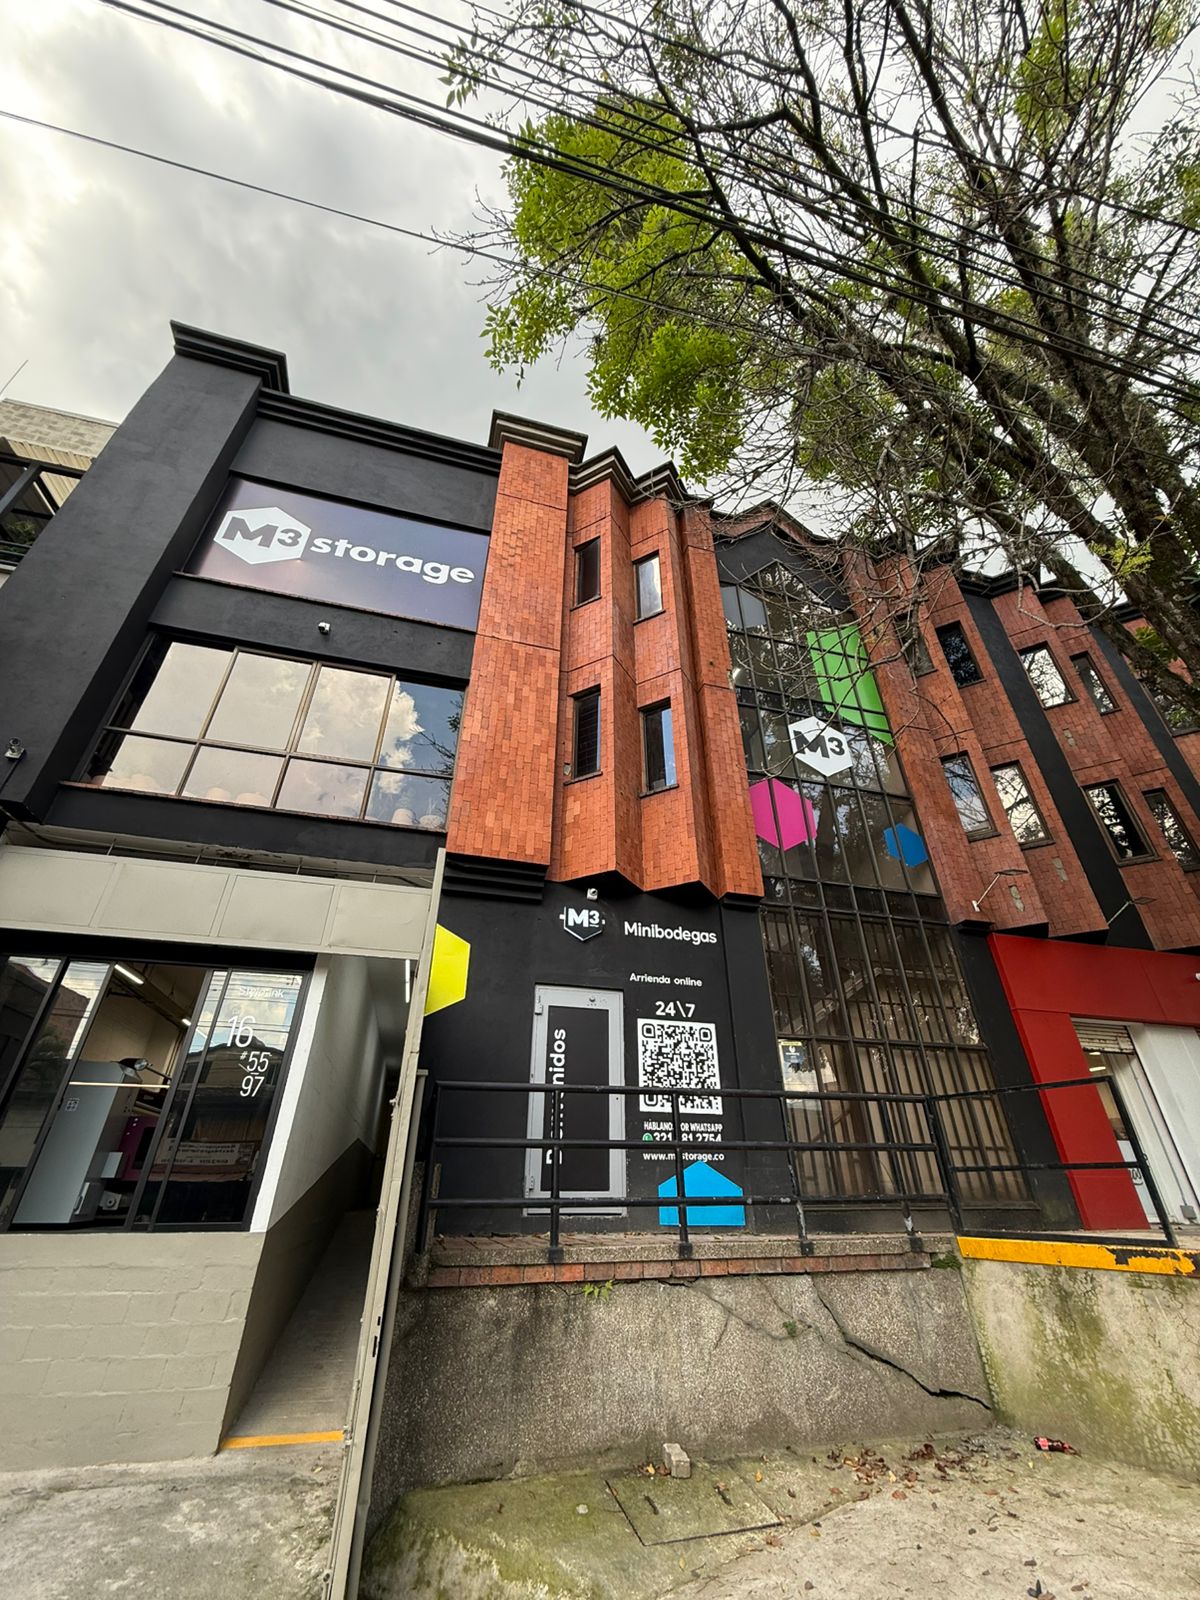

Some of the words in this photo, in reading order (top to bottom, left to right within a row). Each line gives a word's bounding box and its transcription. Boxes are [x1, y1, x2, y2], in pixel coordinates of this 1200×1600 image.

[222, 516, 303, 548] M3
[310, 537, 475, 585] storage
[793, 730, 845, 758] M3
[567, 907, 600, 928] M3
[624, 921, 718, 945] Minibodegas
[629, 972, 671, 985] Arrienda
[673, 977, 703, 987] online
[226, 1015, 256, 1048] 16
[239, 1075, 265, 1097] 97
[690, 1122, 723, 1132] WHATSAPP
[643, 1152, 725, 1162] www.mstorage.co
